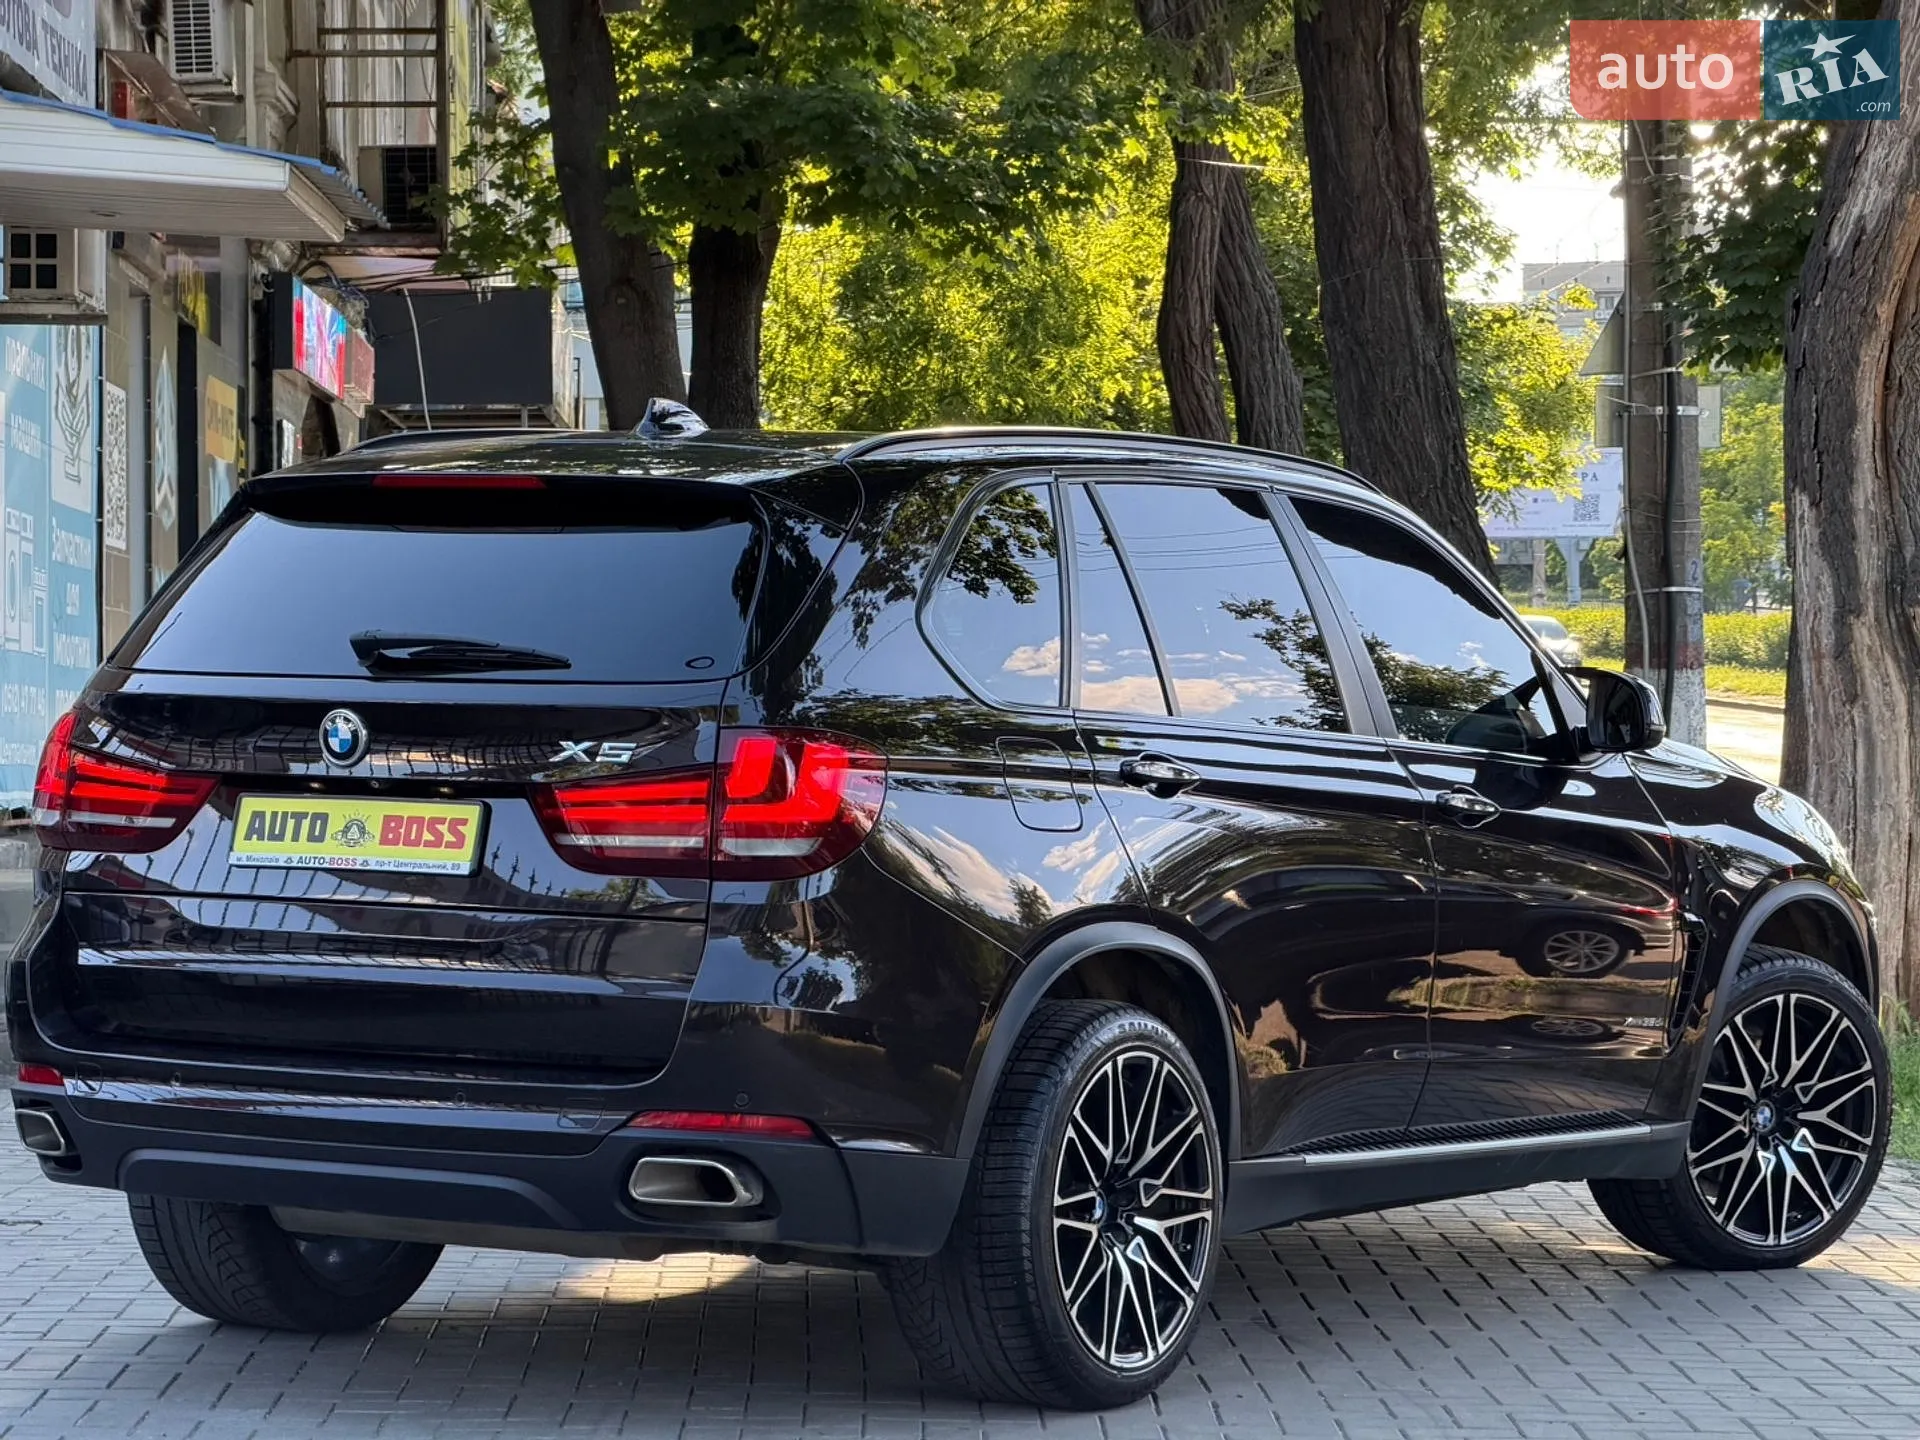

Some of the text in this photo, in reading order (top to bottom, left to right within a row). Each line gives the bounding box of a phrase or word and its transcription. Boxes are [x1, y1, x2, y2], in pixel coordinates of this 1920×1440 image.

[41, 17, 88, 101] ТЕХНІКА
[549, 741, 637, 763] X5
[243, 811, 469, 849] AUTO BOSS
[296, 856, 357, 867] AUTO-BOSS
